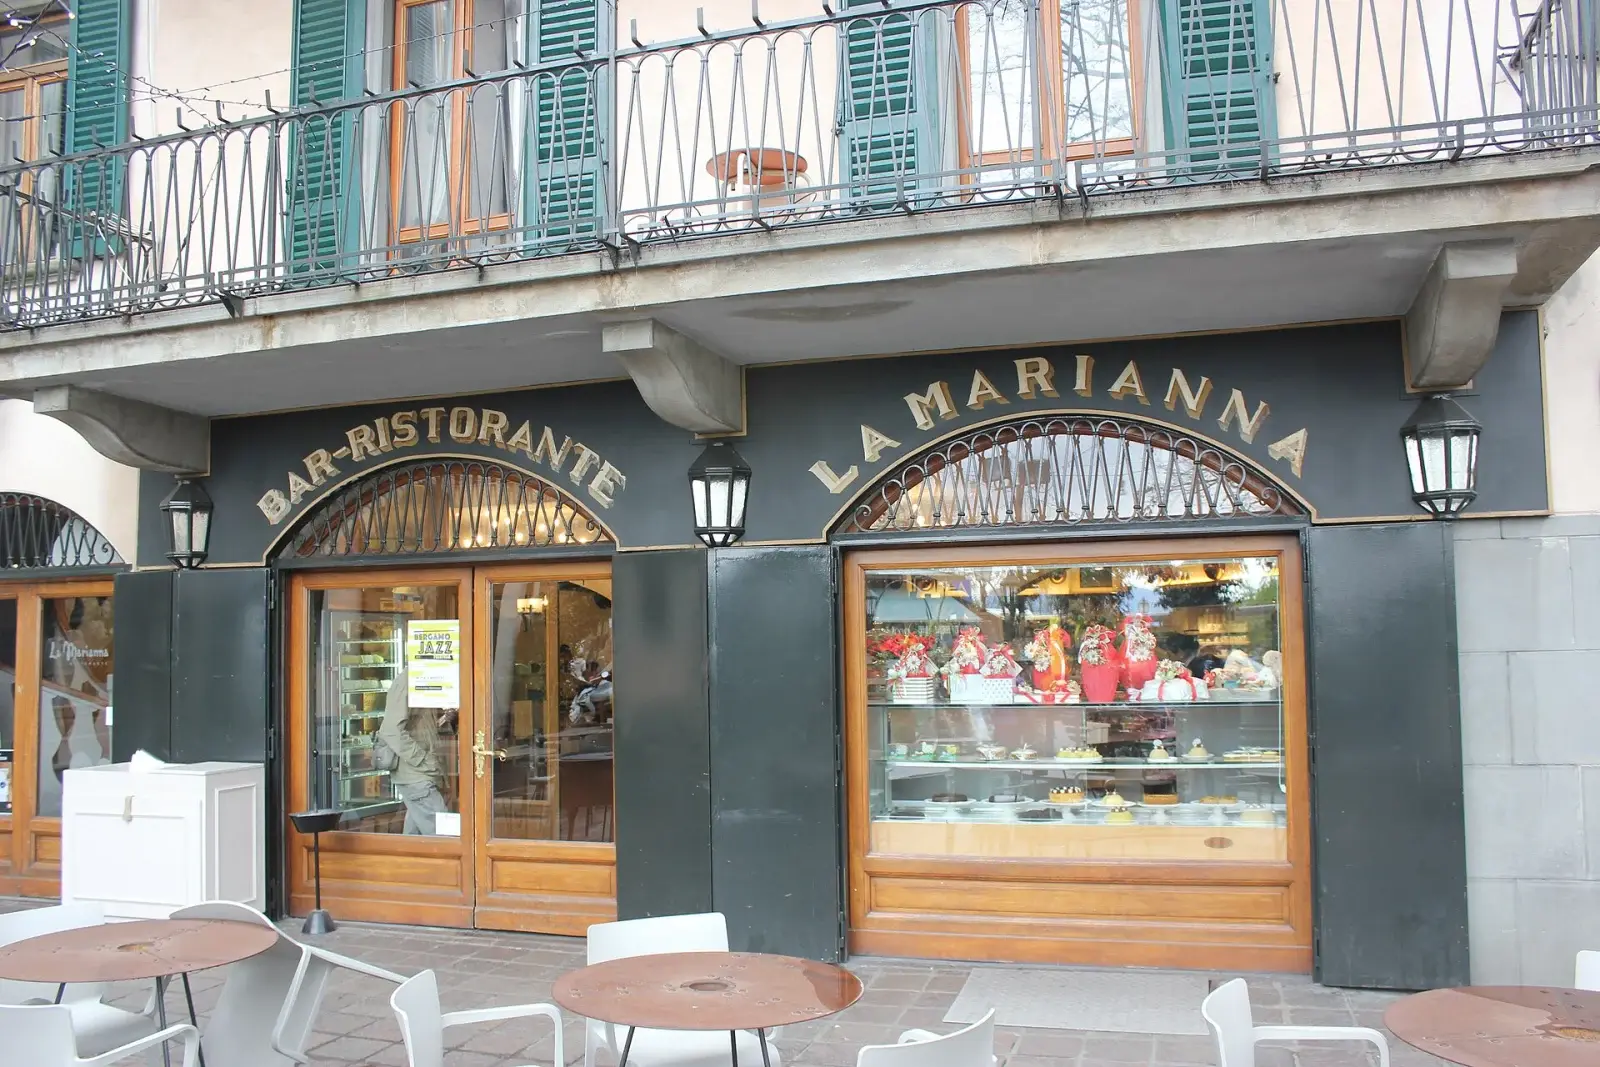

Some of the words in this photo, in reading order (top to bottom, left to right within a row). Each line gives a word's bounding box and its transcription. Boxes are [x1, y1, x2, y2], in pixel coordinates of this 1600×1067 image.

[808, 423, 901, 495] LA
[903, 354, 1309, 480] MARIANNA
[256, 405, 627, 526] BAR-RISTORANTE
[62, 641, 109, 661] Marianna
[418, 641, 452, 654] JAZZ
